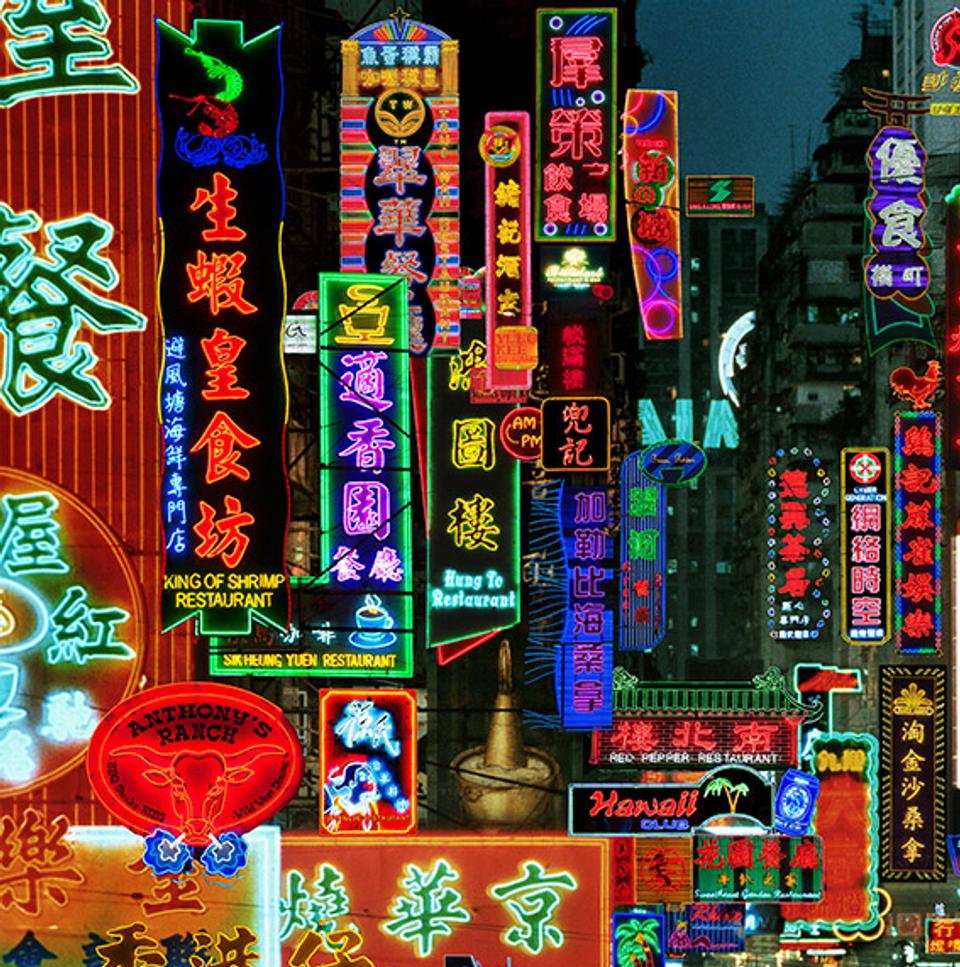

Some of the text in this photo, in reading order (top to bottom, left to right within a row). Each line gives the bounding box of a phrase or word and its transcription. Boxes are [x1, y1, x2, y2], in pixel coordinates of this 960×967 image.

[512, 416, 537, 430] AM
[850, 503, 882, 626] 網絡時空
[164, 573, 286, 592] KING OF SHRIMP
[443, 568, 504, 590] Hung To
[176, 591, 275, 610] RESTAURANT
[432, 587, 516, 610] Restaurant
[322, 653, 397, 668] RESTAURANT
[127, 703, 273, 739] ANTHONY'S
[157, 723, 239, 746] RANCH
[609, 752, 779, 764] RED PEPPER RESTAURANT
[589, 789, 699, 818] Hawaii
[900, 721, 927, 864] 淘金沙桑拿
[640, 818, 690, 831] CLUB
